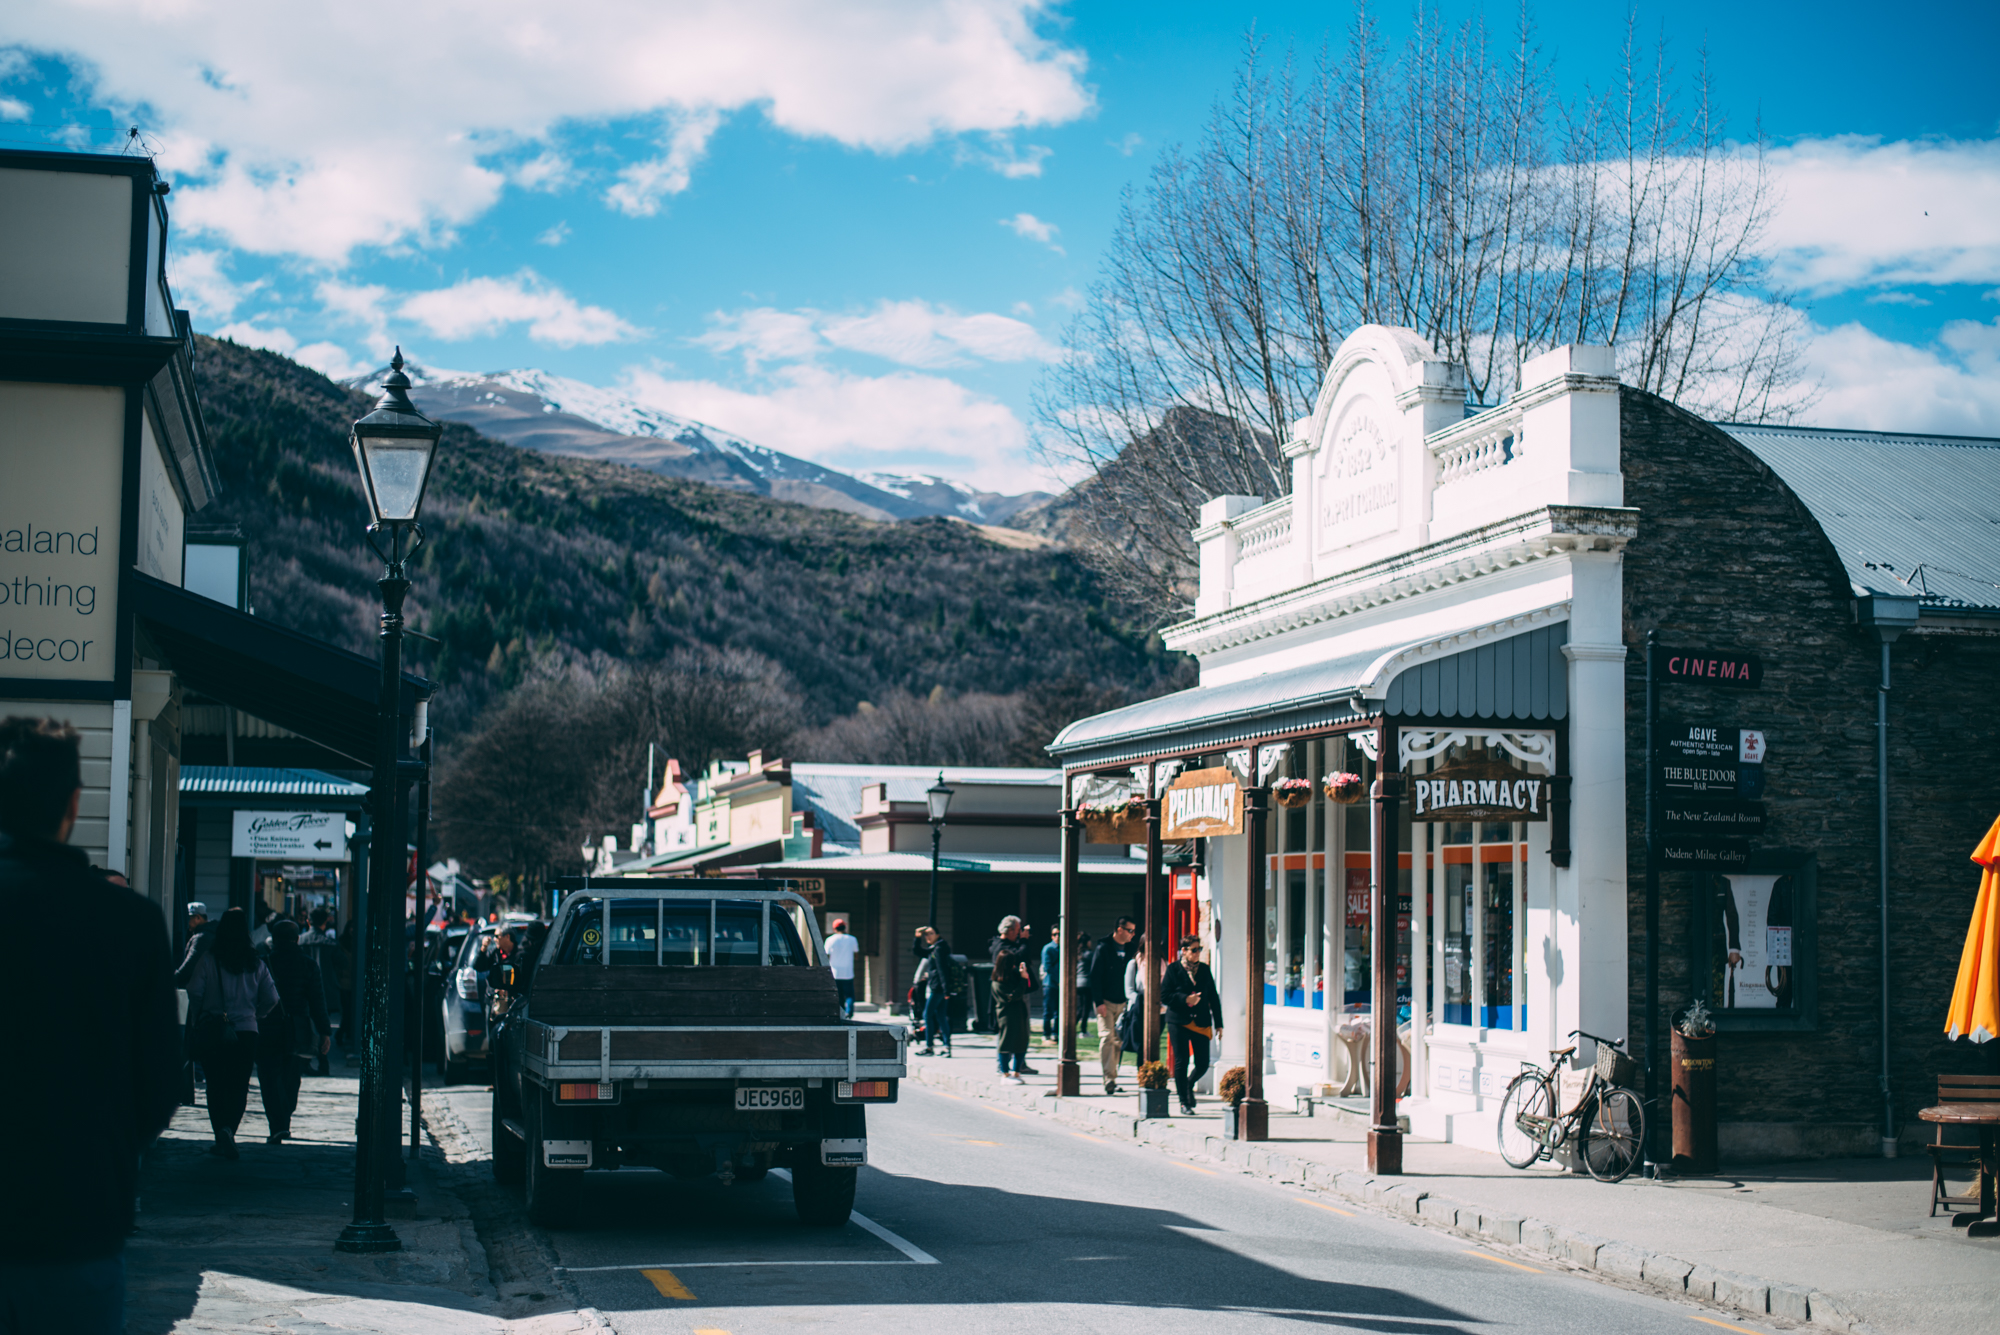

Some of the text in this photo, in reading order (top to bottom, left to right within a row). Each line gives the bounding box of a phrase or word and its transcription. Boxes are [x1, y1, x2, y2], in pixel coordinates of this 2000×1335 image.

[1668, 657, 1749, 680] CINEMA
[1689, 727, 1717, 741] AGAVE
[1670, 740, 1733, 751] AUTHENTIC MEXICAN
[1664, 767, 1736, 782] THE BLUE DOOR
[1693, 782, 1707, 790] BAR
[1415, 779, 1541, 814] PHARMACY
[1167, 782, 1236, 832] PHARMACY
[248, 816, 289, 834] Golden
[1666, 810, 1761, 823] The New Zealand Room
[1665, 847, 1746, 864] Nadene Milne Gallery
[789, 880, 821, 891] HED
[1347, 894, 1369, 914] SALE
[737, 1090, 802, 1107] JEC960
